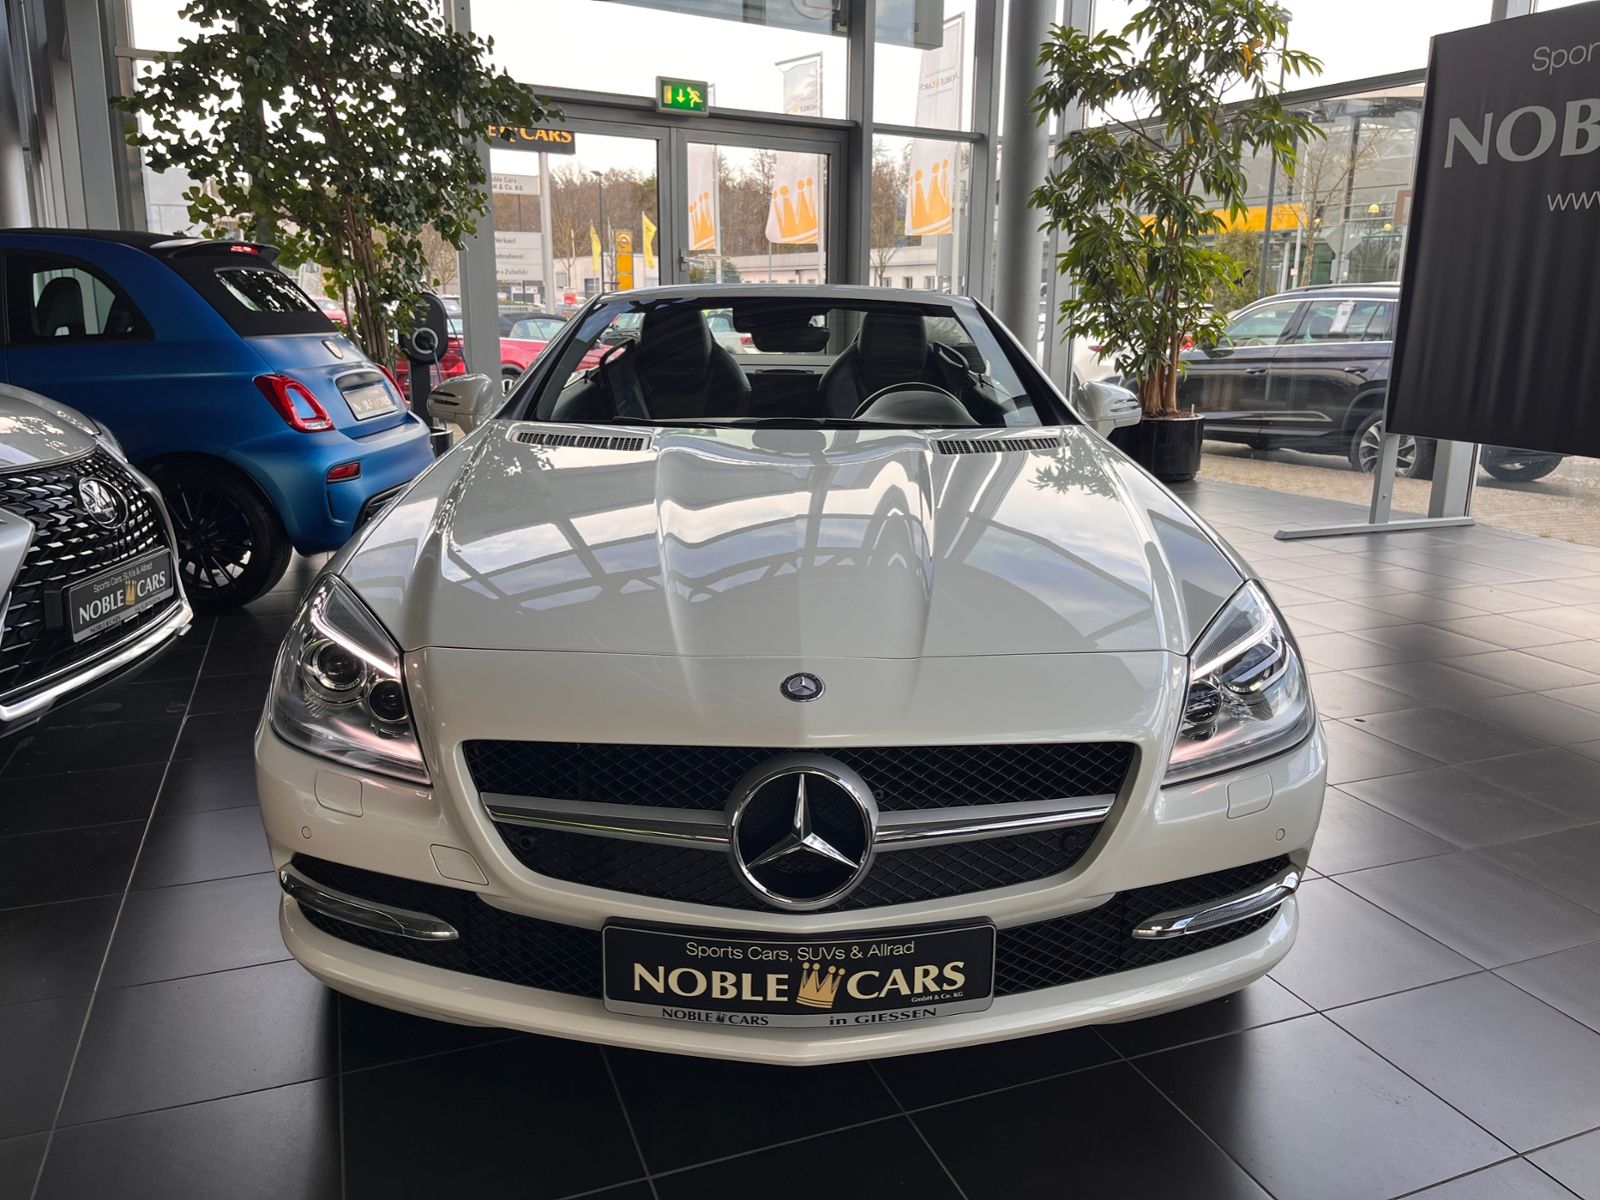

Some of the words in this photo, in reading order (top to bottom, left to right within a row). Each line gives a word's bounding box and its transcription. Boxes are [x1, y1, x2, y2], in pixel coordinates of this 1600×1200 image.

[519, 127, 573, 144] CARS
[79, 589, 124, 625] NOBLE
[137, 570, 166, 597] CARS
[686, 942, 743, 960] Sports
[747, 946, 793, 962] Cars,
[797, 946, 846, 961] SUVs
[850, 946, 863, 959] &
[867, 941, 915, 958] Allrad
[633, 962, 789, 1002] NOBLE
[846, 961, 966, 1000] CARS
[911, 994, 933, 1003] GmbH
[934, 993, 939, 1001] &
[662, 1008, 713, 1022] NOBLE
[728, 1014, 769, 1026] CARS
[829, 1016, 847, 1025] in
[854, 1008, 937, 1024] GIESSEN
